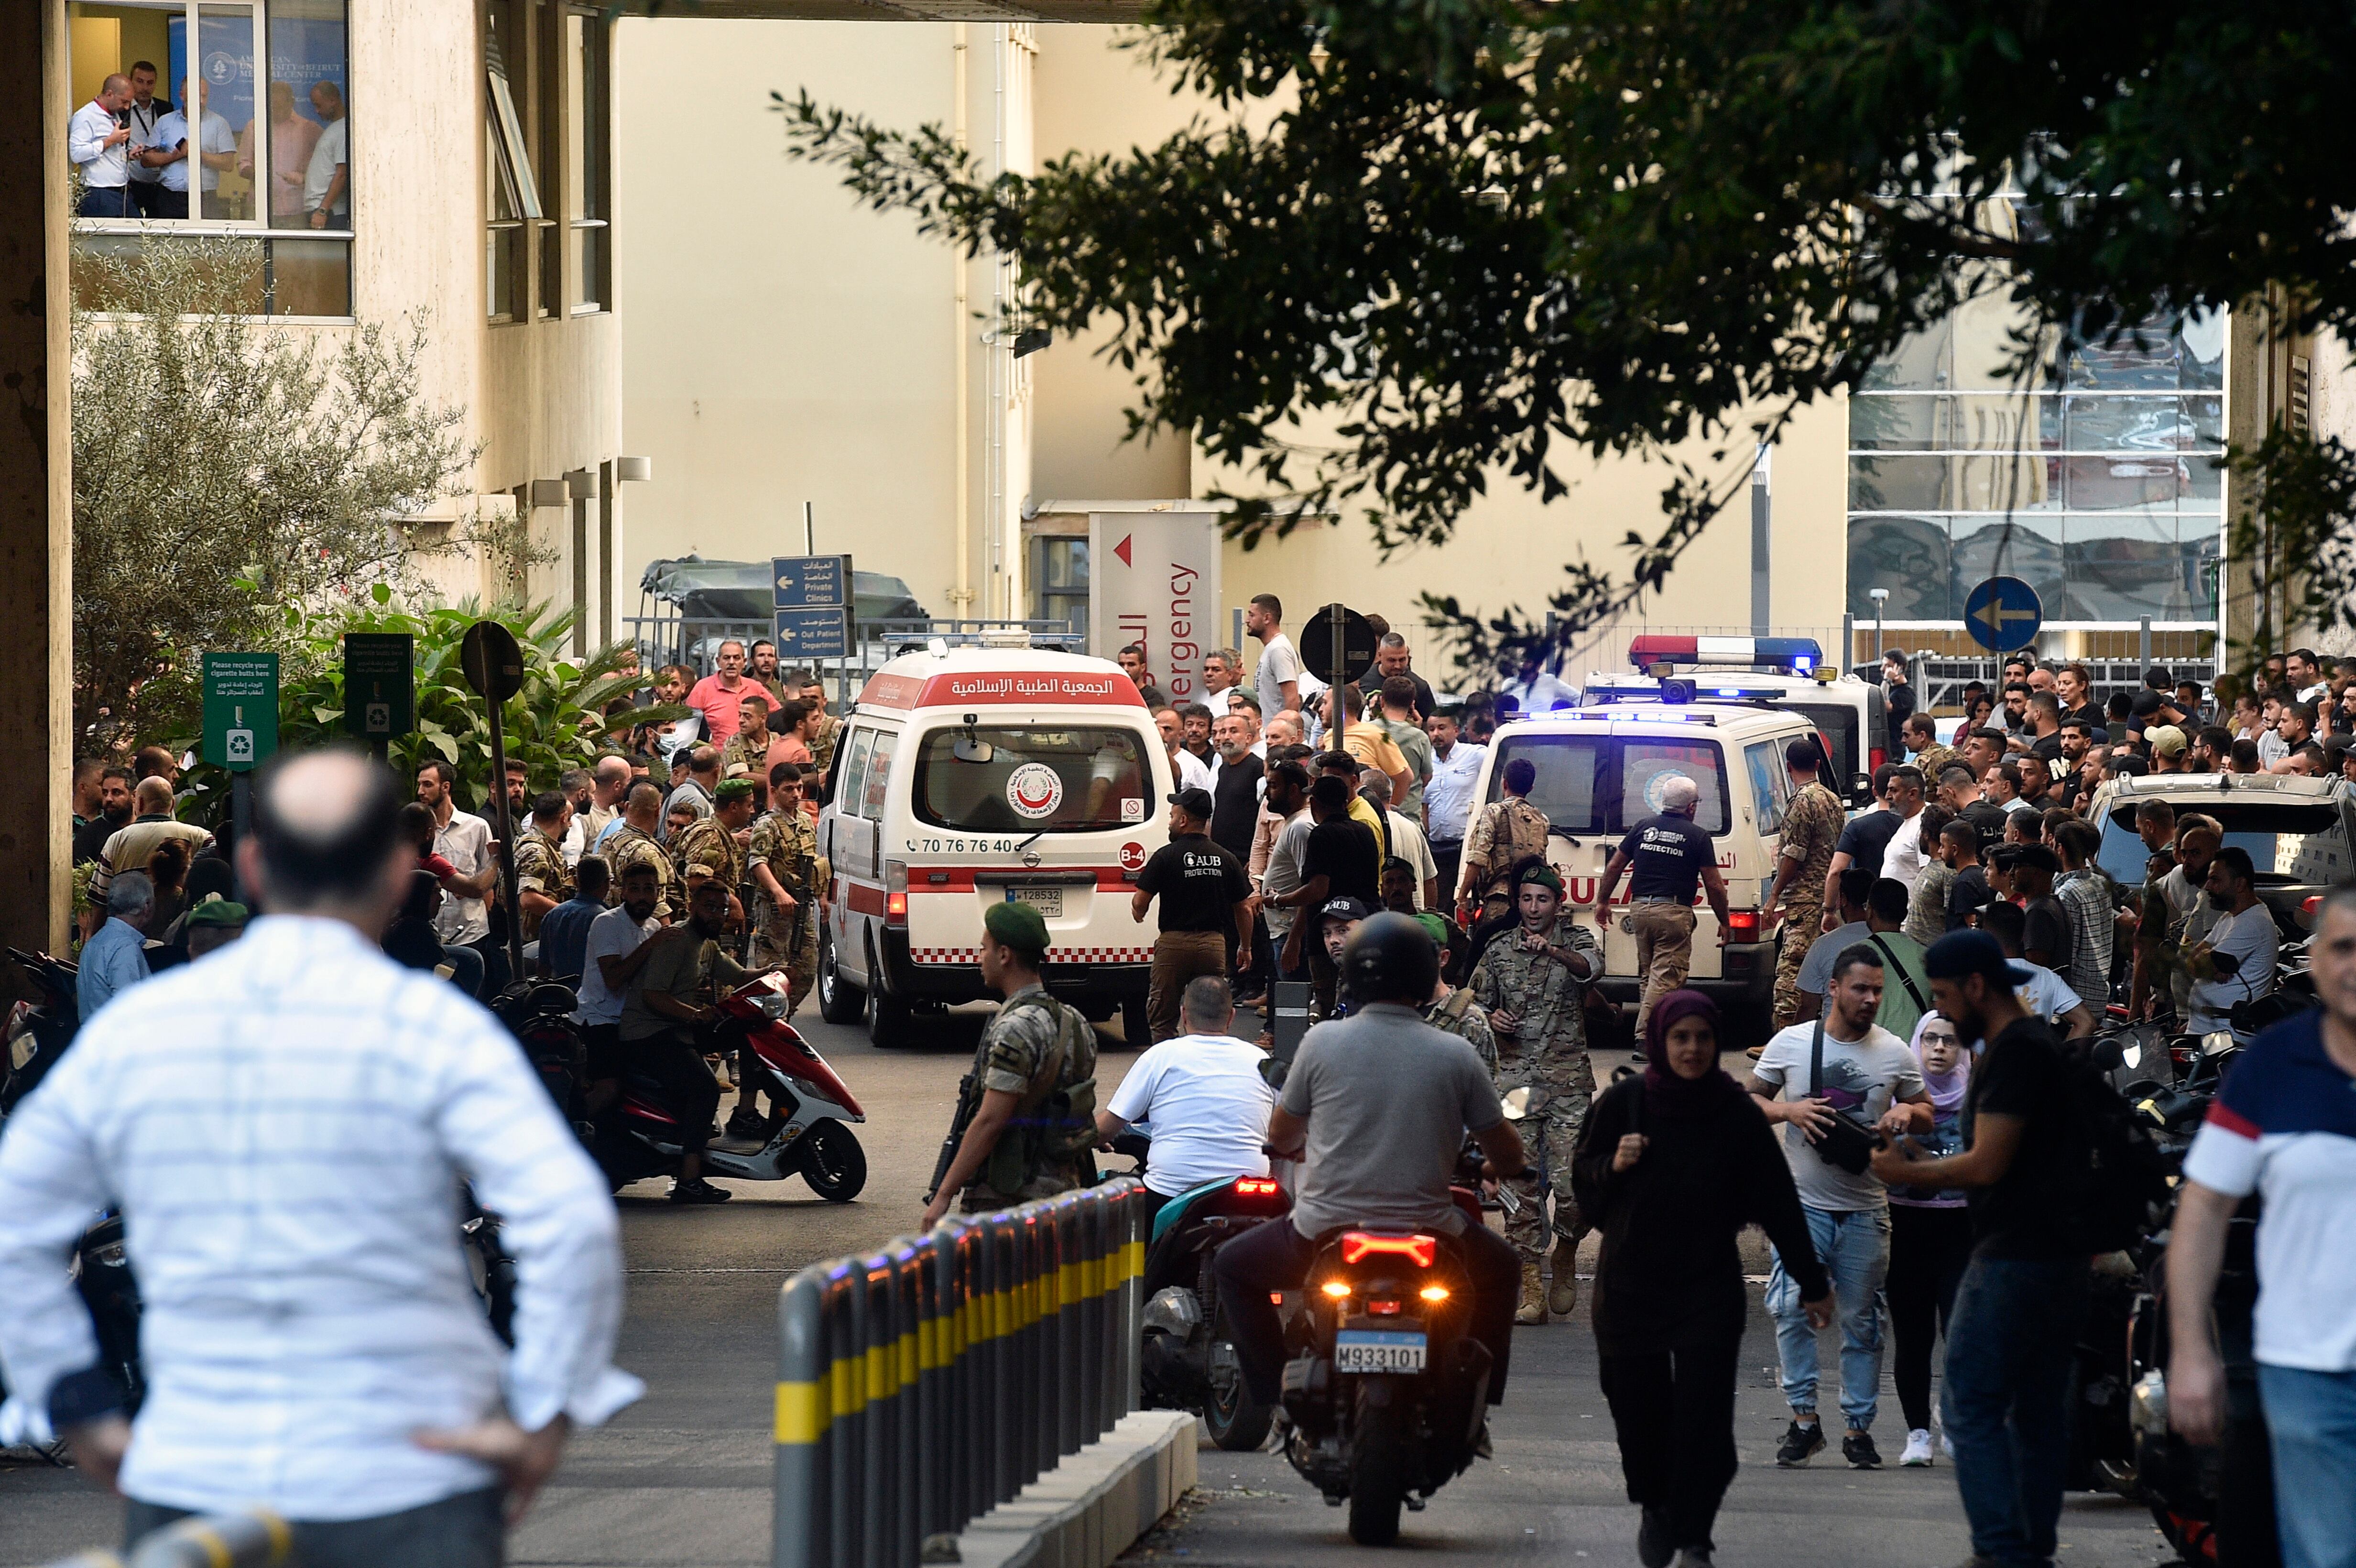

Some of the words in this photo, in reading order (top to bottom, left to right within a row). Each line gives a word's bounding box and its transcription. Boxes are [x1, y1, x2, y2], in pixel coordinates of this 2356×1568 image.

[803, 561, 833, 570] العيادات
[951, 678, 1012, 697] الإسلامية
[1016, 678, 1058, 696] الطبية
[1062, 679, 1113, 697] الجمعية
[922, 839, 940, 852] 70
[946, 839, 964, 852] 76
[970, 839, 988, 852] 76
[993, 839, 1011, 852] 40
[1640, 843, 1683, 857] PROTECTION
[1121, 849, 1145, 861] B-4
[1196, 856, 1221, 866] AUB
[1184, 868, 1222, 878] PROTECTION
[1024, 891, 1059, 900] 128532
[1329, 901, 1350, 910] AUB
[1339, 1347, 1420, 1369] M933101
